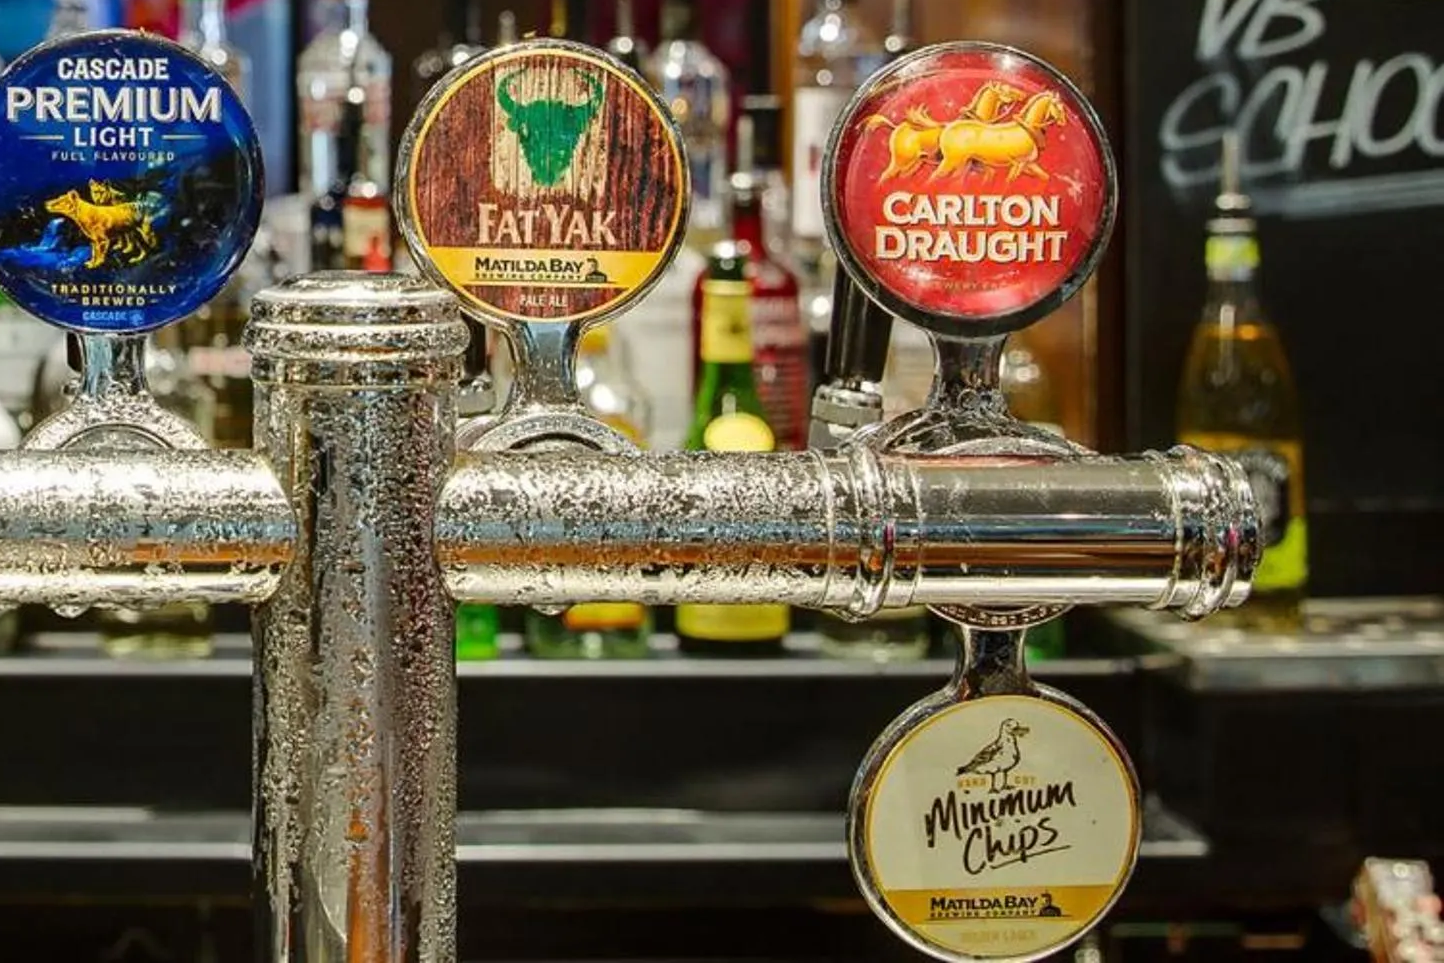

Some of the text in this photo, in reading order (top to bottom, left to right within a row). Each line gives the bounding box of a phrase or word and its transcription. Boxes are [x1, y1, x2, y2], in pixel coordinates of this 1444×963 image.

[57, 57, 169, 80] CASCADE
[6, 86, 223, 123] PREMIUM
[73, 126, 155, 148] LIGHT
[94, 151, 175, 162] FLAVOURED
[882, 190, 1061, 227] CARLTON
[478, 203, 617, 246] FAT YAK
[875, 225, 1069, 264] DRAUGHT
[475, 256, 584, 273] MATILDA BAY
[51, 284, 177, 295] TRADITIONALLY
[82, 296, 146, 306] BREWED
[925, 781, 1077, 849] Minimum
[962, 816, 1059, 876] Chips
[930, 895, 1038, 911] MATILDA BAY
